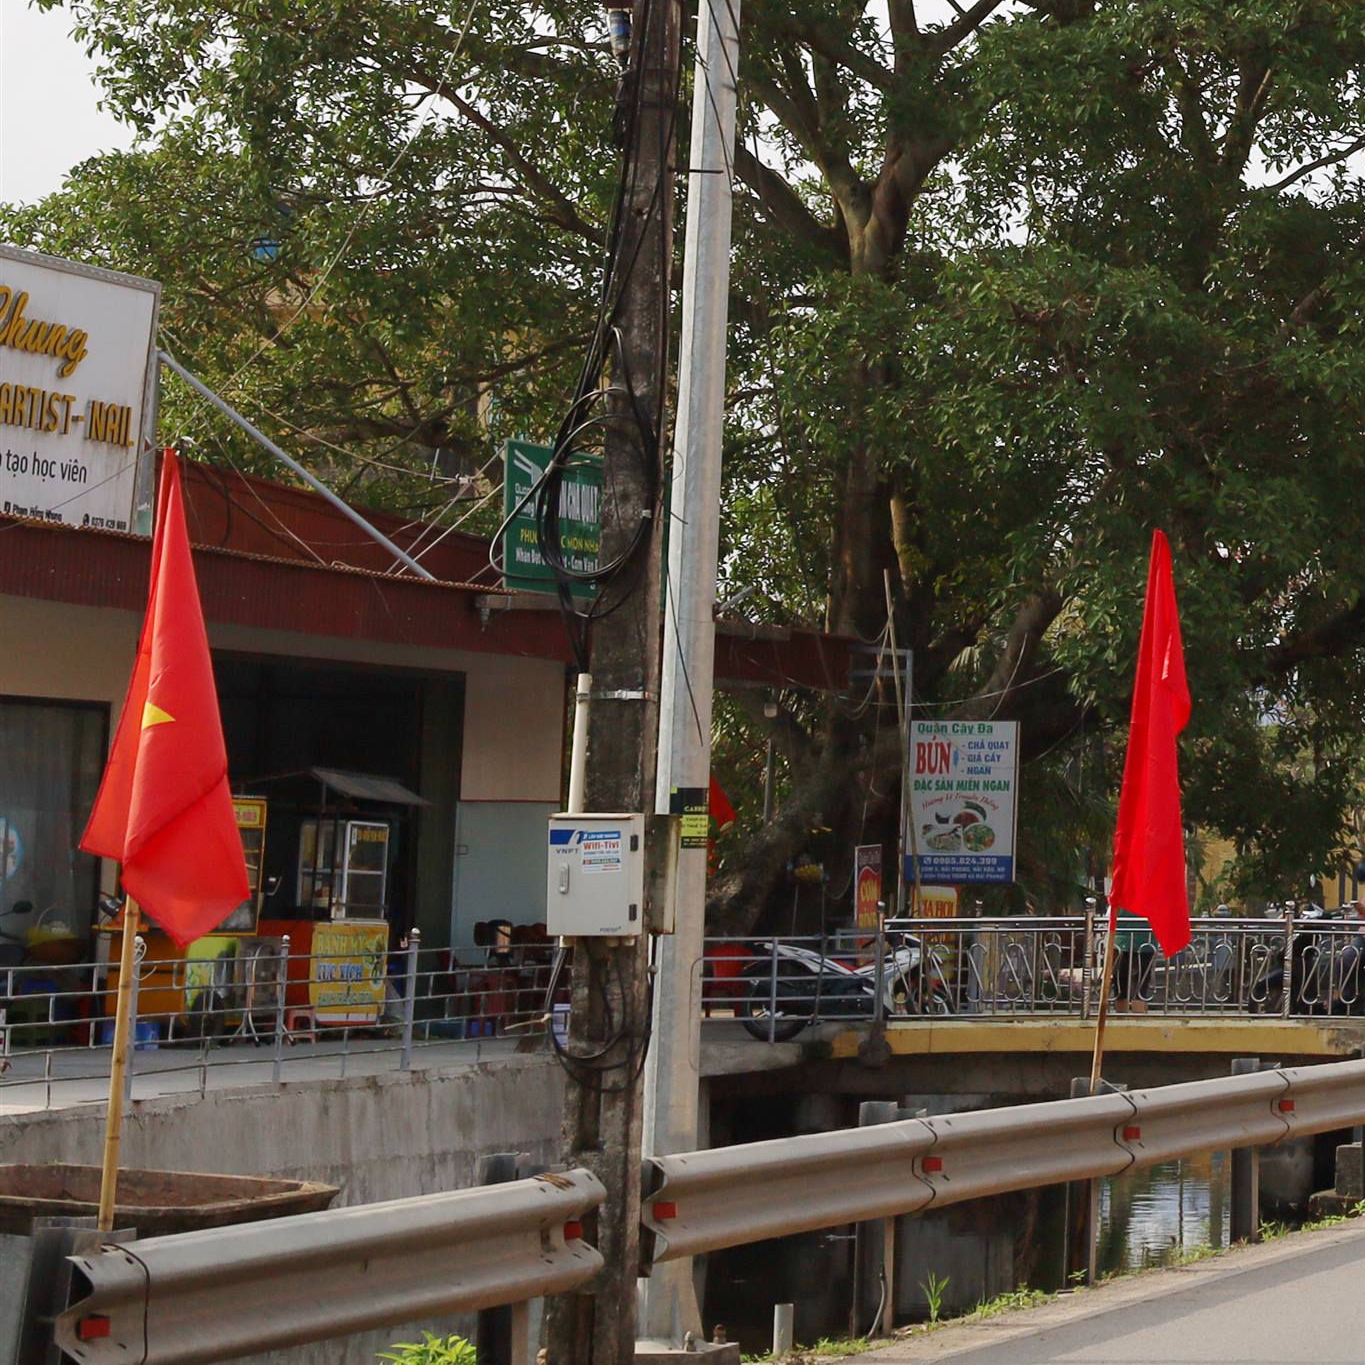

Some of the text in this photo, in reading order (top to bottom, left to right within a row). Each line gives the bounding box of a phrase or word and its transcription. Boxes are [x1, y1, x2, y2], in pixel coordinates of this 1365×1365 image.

[6, 451, 87, 484] tạo học viên
[952, 723, 974, 735] Cây
[977, 723, 993, 734] Đa
